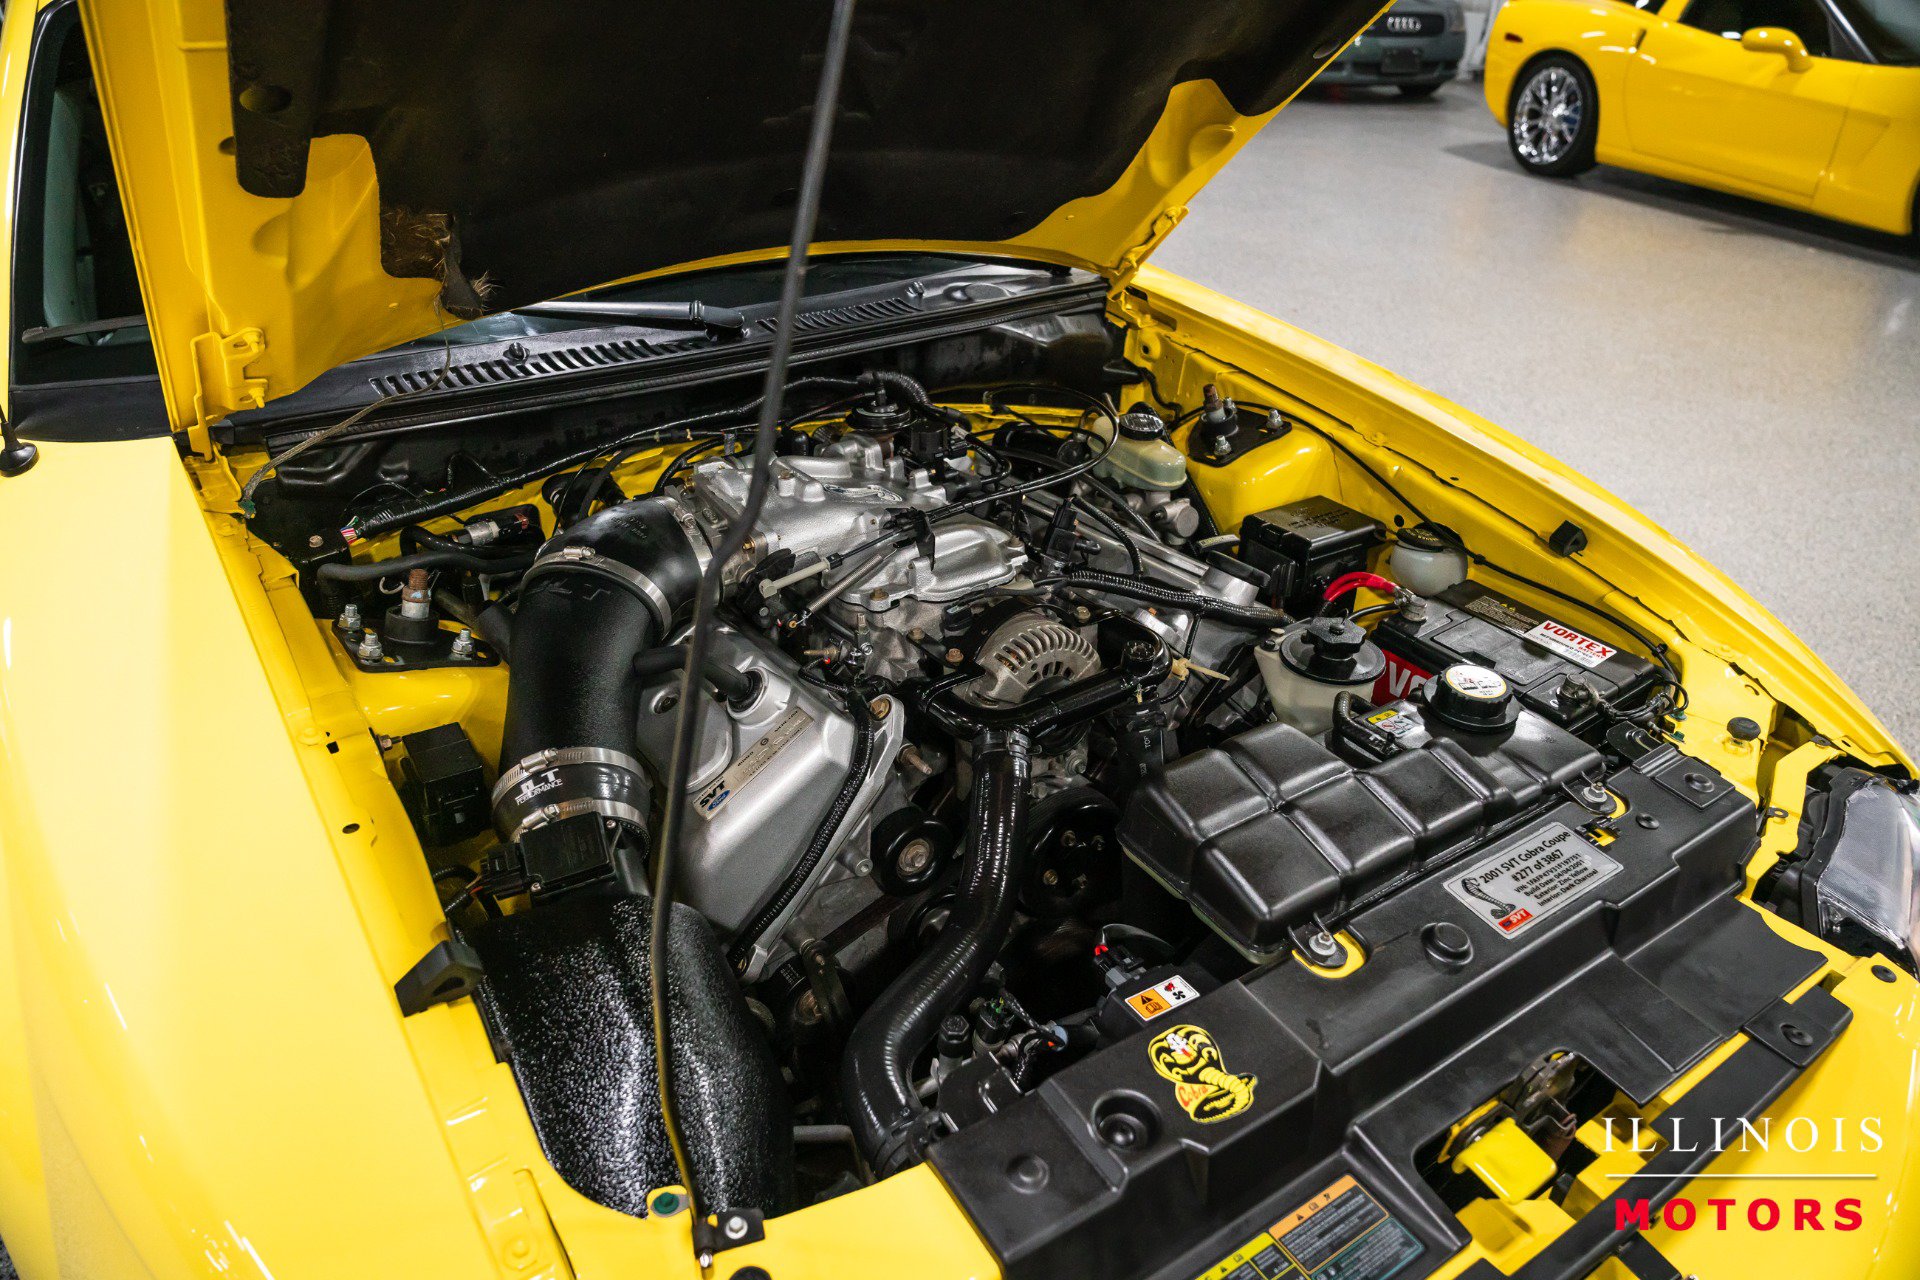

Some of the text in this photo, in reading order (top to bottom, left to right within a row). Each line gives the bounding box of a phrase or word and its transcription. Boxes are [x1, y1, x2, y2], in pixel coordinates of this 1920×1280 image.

[1543, 622, 1613, 657] VORTEX
[515, 768, 559, 800] JLT
[516, 779, 563, 805] PERFORMANCE
[700, 780, 725, 807] SVT
[1479, 831, 1571, 884] 2001 SVT Cobra Coupe
[1511, 849, 1564, 882] #277 of 3867
[1514, 884, 1528, 893] VIN:
[1524, 885, 1541, 897] Build
[1539, 876, 1555, 888] Date:
[1534, 866, 1588, 900] Exterior: Zinc Yellow
[1537, 869, 1599, 907] Interior: Dark Charcoal
[1510, 910, 1527, 923] SVT
